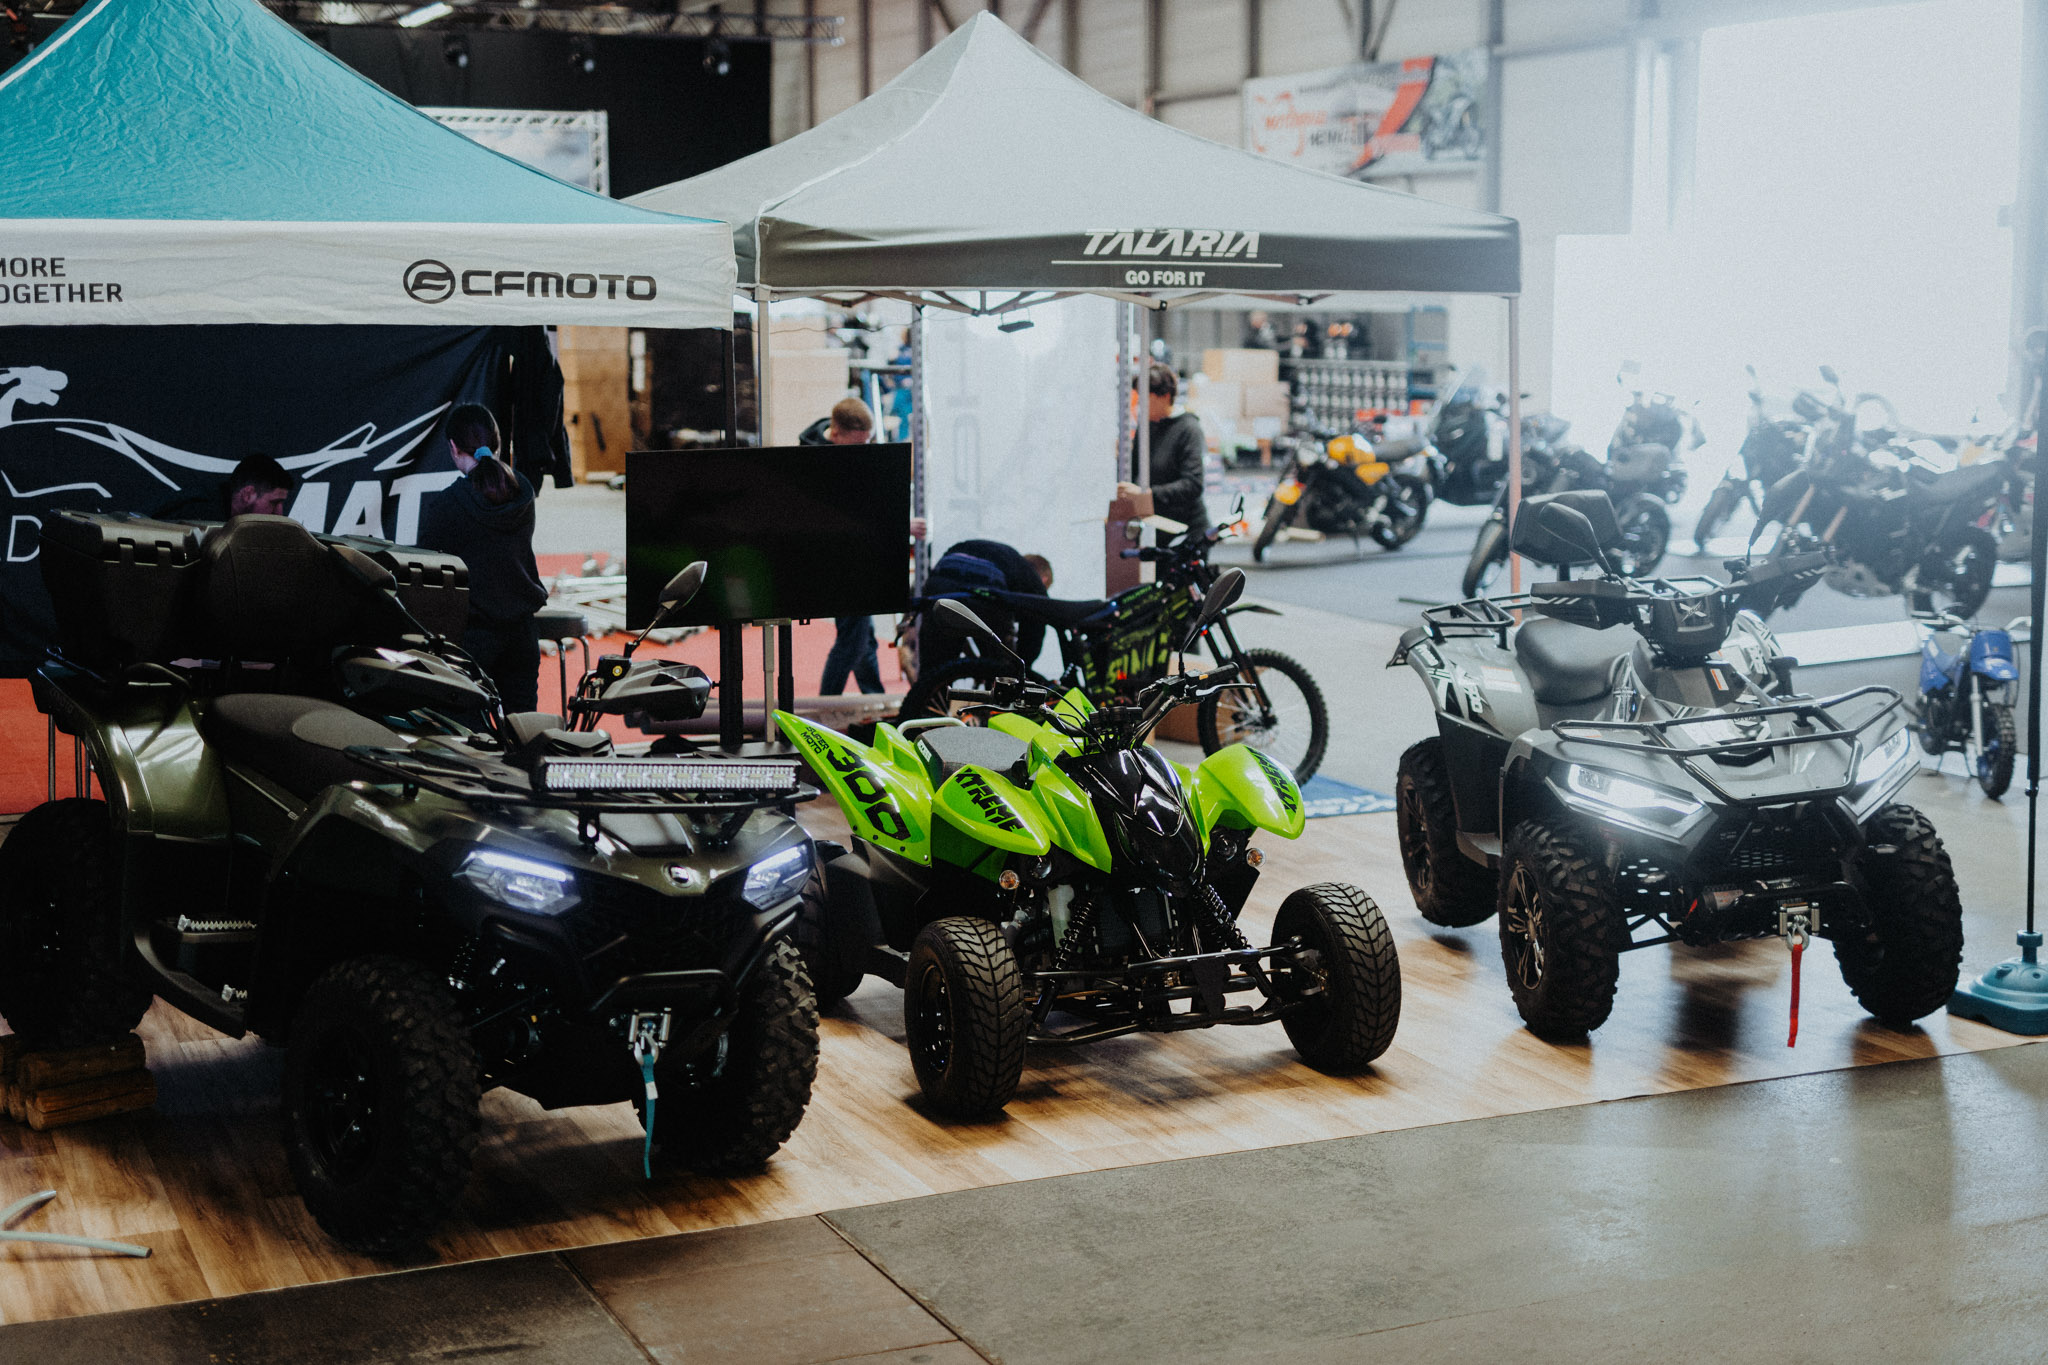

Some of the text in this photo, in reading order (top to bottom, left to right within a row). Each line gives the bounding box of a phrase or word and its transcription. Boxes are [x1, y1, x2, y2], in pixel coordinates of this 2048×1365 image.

[1083, 228, 1260, 258] TALARIA
[461, 269, 657, 302] CFMOTO
[1125, 270, 1206, 286] GO FOR IT
[800, 731, 822, 755] MOTO
[805, 726, 830, 751] SUPER
[826, 745, 911, 841] 300
